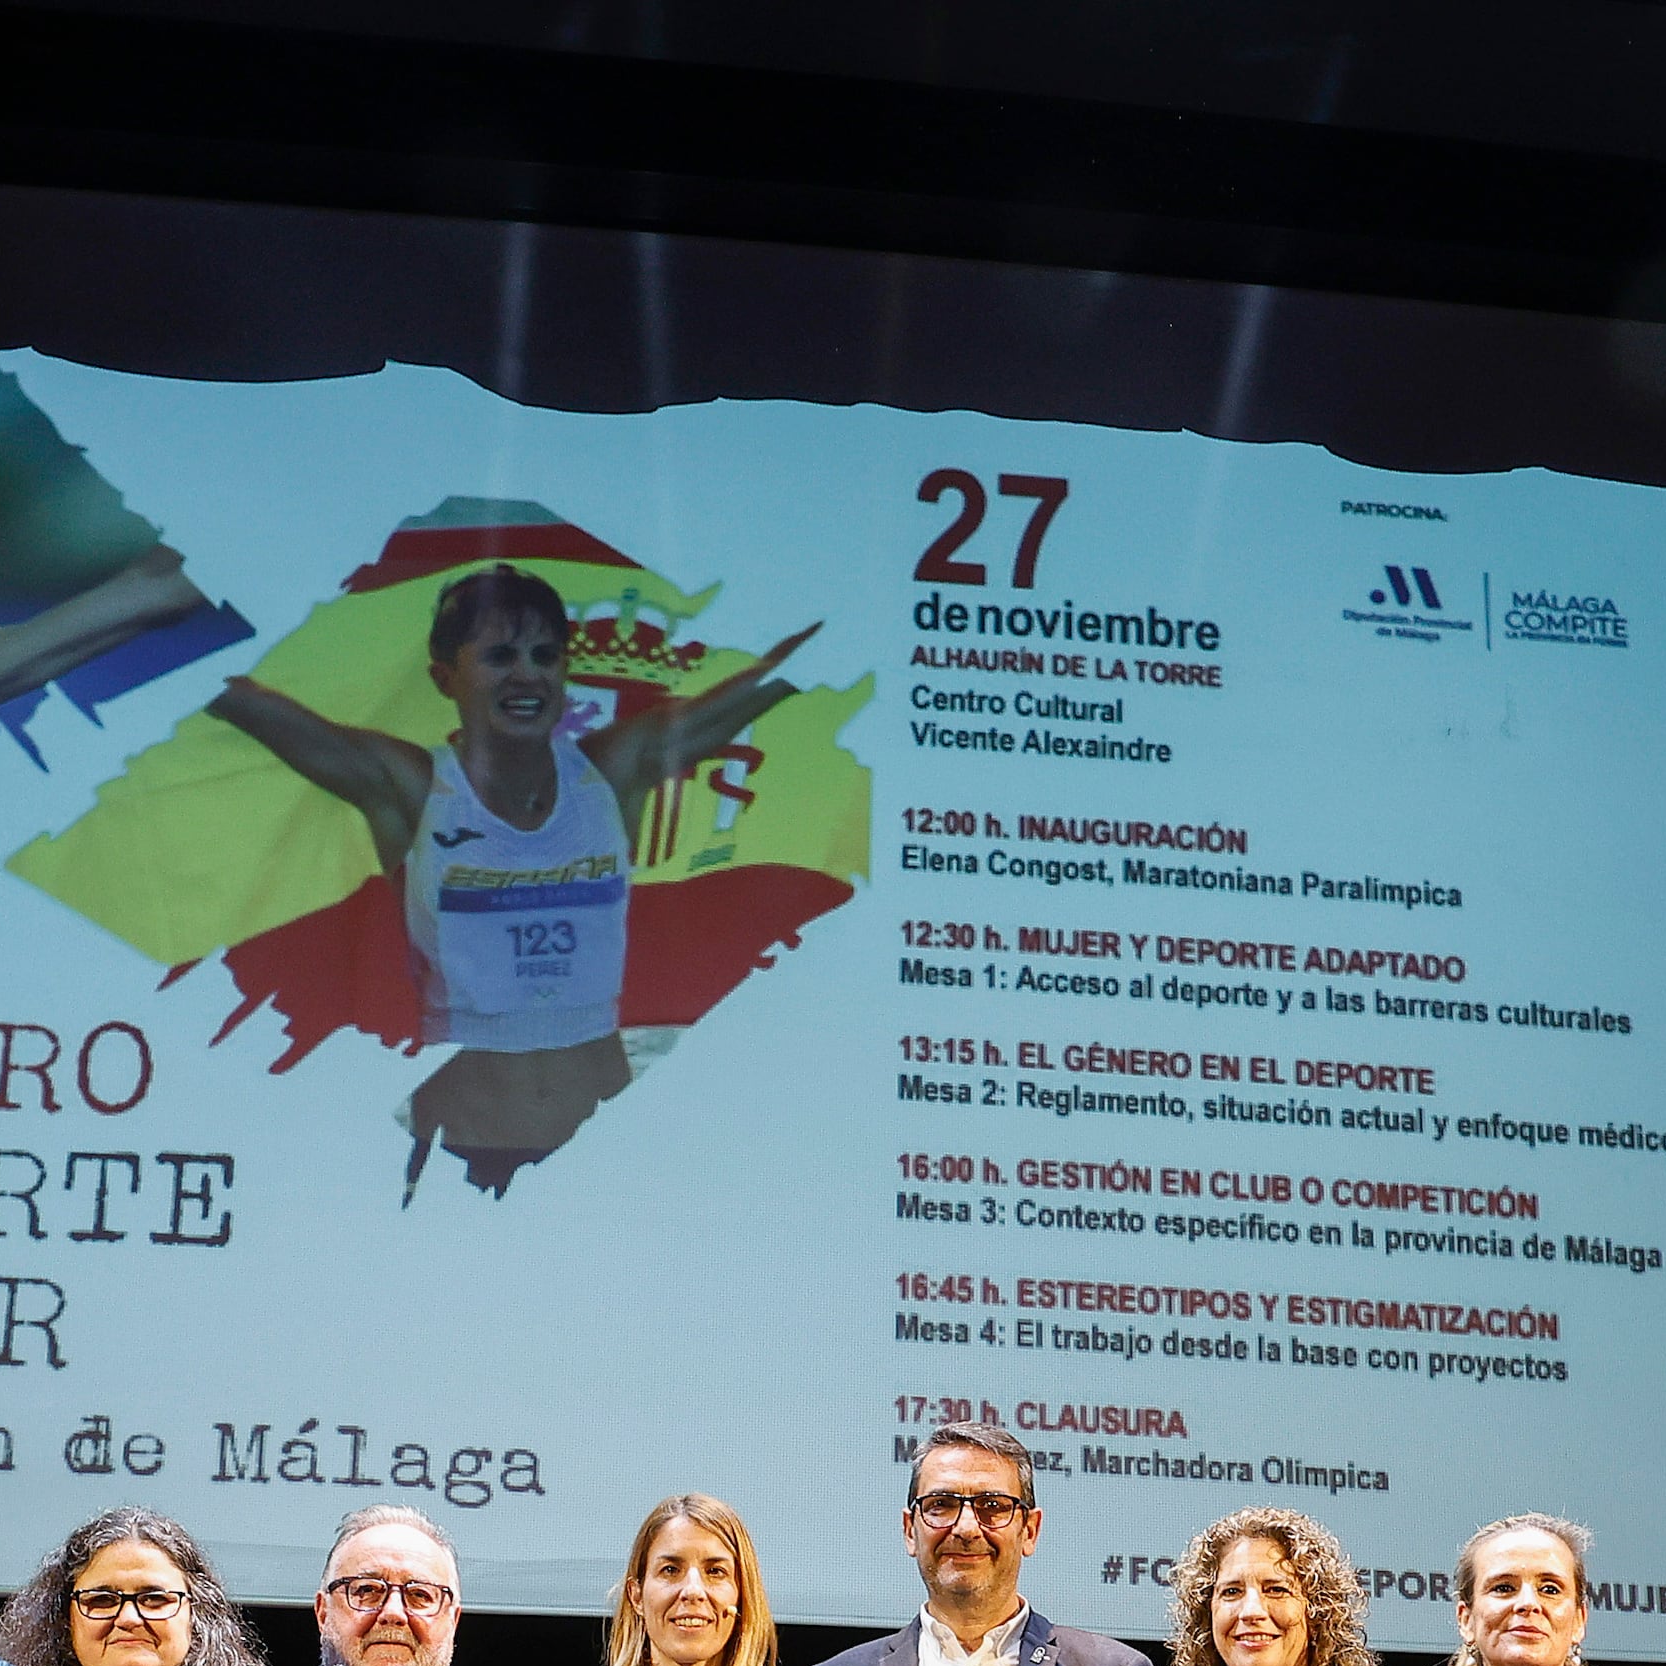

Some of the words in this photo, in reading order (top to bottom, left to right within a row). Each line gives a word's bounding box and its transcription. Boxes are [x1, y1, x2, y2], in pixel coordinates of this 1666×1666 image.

[913, 467, 1070, 590] 27
[977, 599, 1222, 652] noviembre
[1504, 610, 1629, 638] COMPITE
[1051, 653, 1088, 679] DE
[1094, 657, 1129, 681] LA
[1133, 659, 1223, 689] TORRE
[910, 683, 1007, 716] Centro
[1013, 690, 1123, 724] Cultural
[910, 720, 1016, 753] Vicente
[1020, 729, 1173, 764] Alexaindre
[901, 807, 978, 837] 12:00
[984, 812, 1010, 839] h.
[1018, 814, 1248, 856] INAUGURACIÓN
[901, 843, 979, 874] Elena
[987, 849, 1114, 887] Congost,
[1122, 857, 1294, 896] Maratoniana
[506, 919, 577, 958] 123
[901, 919, 977, 951] 12:30
[982, 924, 1010, 952] h.
[1018, 926, 1122, 961] MUJER
[1128, 933, 1150, 962] Y
[1156, 935, 1297, 973] DEPORTE
[1303, 946, 1466, 984] ADAPTADO
[899, 957, 972, 988] Mesa
[983, 963, 1008, 990] 1:
[1015, 964, 1121, 997] Acceso
[1129, 973, 1154, 1000] al
[1161, 975, 1268, 1009] deporte
[1276, 989, 1293, 1015] y
[1301, 991, 1318, 1010] a
[1325, 985, 1366, 1014] las
[1374, 988, 1489, 1024] barreras
[1496, 1000, 1634, 1035] culturales
[899, 1035, 976, 1065] 13:15
[982, 1039, 1009, 1067] h.
[1017, 1041, 1055, 1070] EL
[1062, 1043, 1192, 1079] GÉNERO
[1199, 1053, 1241, 1082] EN
[1249, 1056, 1288, 1085] EL
[1295, 1059, 1435, 1096] DEPORTE
[897, 1073, 972, 1104] Mesa
[982, 1079, 1006, 1107] 2:
[1016, 1080, 1194, 1123] Reglamento,
[1203, 1093, 1332, 1127] situación
[1341, 1105, 1424, 1134] actual
[1431, 1114, 1450, 1142] y
[1457, 1112, 1571, 1149] enfoque
[897, 1153, 975, 1184] 16:00
[982, 1157, 1009, 1185] h.
[1016, 1158, 1152, 1195] GESTIÓN
[1159, 1167, 1201, 1197] EN
[1208, 1170, 1292, 1204] CLUB
[1299, 1176, 1325, 1207] O
[1331, 1178, 1540, 1222] COMPETICIÓN
[896, 1191, 972, 1223] Mesa
[980, 1196, 1006, 1225] 3:
[1016, 1198, 1147, 1234] Contexto
[1154, 1212, 1302, 1244] específico
[1306, 1224, 1342, 1246] en
[1351, 1219, 1375, 1249] la
[1384, 1226, 1515, 1258] provincia
[1522, 1232, 1557, 1262] de
[1563, 1234, 1663, 1275] Málaga
[895, 1272, 975, 1304] 16:45
[981, 1277, 1009, 1306] h.
[1016, 1277, 1252, 1322] ESTEREOTIPOS
[1257, 1294, 1280, 1322] Y
[1287, 1294, 1560, 1342] ESTIGMATIZACIÓN
[895, 1311, 969, 1344] Mesa
[979, 1319, 1006, 1346] 4:
[1016, 1318, 1044, 1348] El
[1051, 1323, 1153, 1361] trabajo
[1161, 1328, 1250, 1361] desde
[1257, 1333, 1282, 1363] la
[1291, 1335, 1358, 1369] base
[1367, 1348, 1419, 1372] con
[1428, 1352, 1569, 1384] proyectos
[894, 1395, 972, 1424] 17:30
[1016, 1401, 1188, 1439] CLAUSURA
[63, 1414, 166, 1477] de
[211, 1417, 546, 1508] Málaga
[1082, 1444, 1254, 1483] Marchadora
